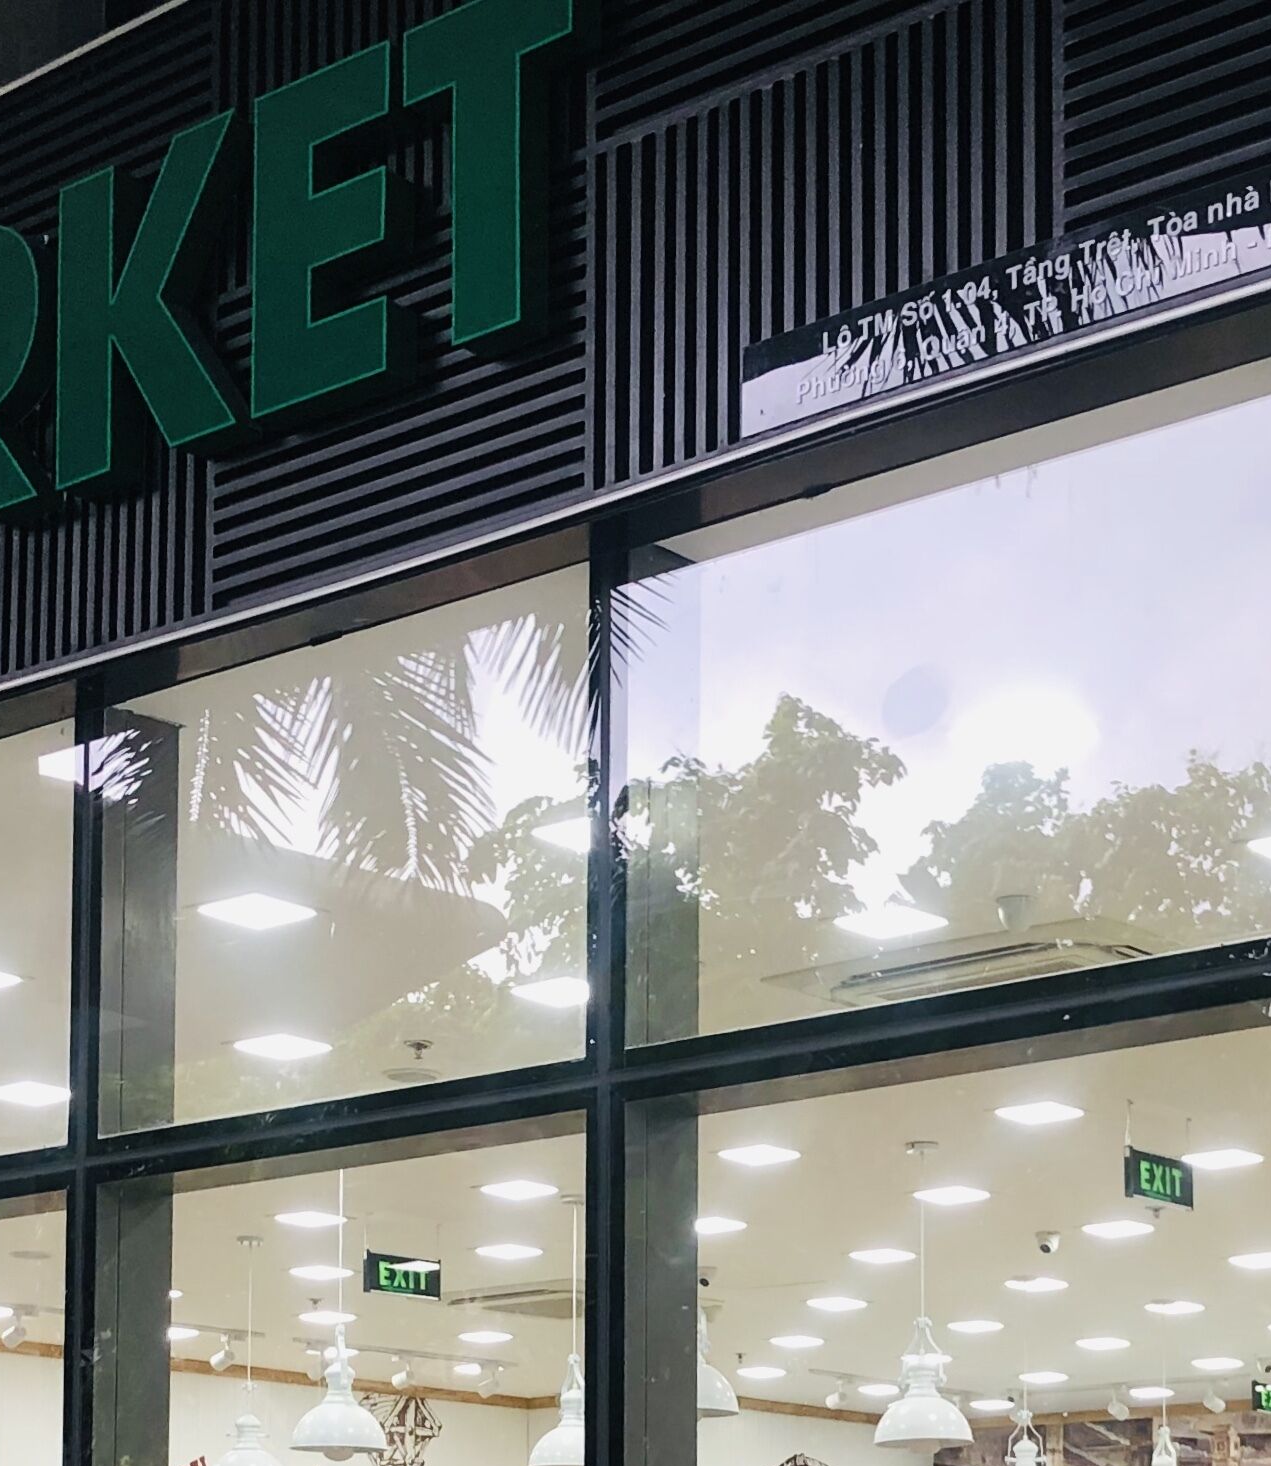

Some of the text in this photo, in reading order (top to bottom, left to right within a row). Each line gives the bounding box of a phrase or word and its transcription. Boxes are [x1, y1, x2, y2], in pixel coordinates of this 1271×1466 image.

[900, 293, 933, 326] Số
[1005, 251, 1071, 291] Tầng
[1147, 207, 1198, 241] Tòa
[1206, 185, 1261, 224] nhà
[1170, 238, 1239, 281] Minh
[1139, 1159, 1183, 1198] EXIT
